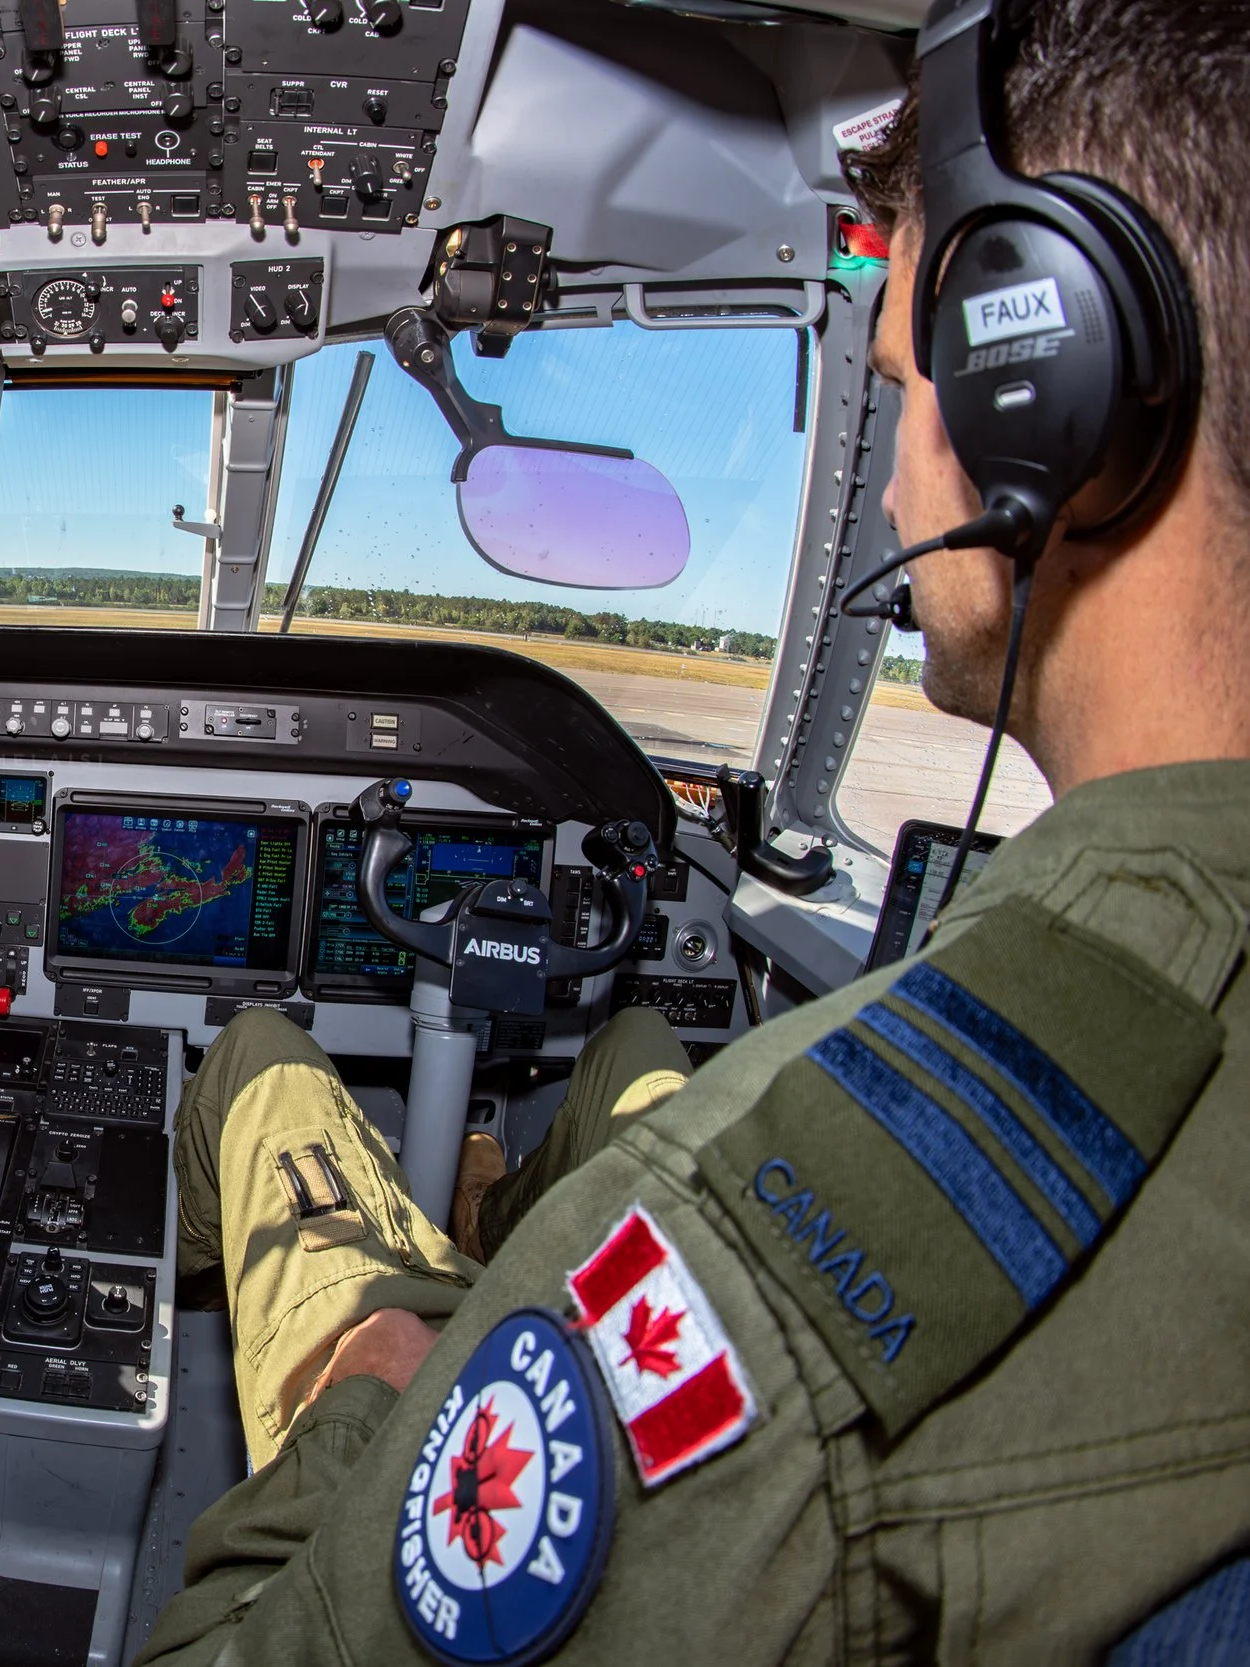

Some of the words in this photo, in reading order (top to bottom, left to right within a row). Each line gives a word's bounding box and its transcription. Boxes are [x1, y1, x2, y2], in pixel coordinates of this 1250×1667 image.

[293, 14, 312, 22] COLD
[349, 17, 368, 25] COLD
[64, 29, 98, 40] FLIGHT
[101, 28, 127, 37] DECK
[124, 80, 155, 88] CENTRAL
[330, 80, 348, 89] CVR
[65, 86, 96, 95] CENTRAL
[304, 126, 344, 135] INTERNAL
[347, 128, 358, 136] LT
[841, 119, 873, 138] ESCAPE
[90, 133, 118, 141] ERASE
[120, 132, 142, 140] TEST
[58, 161, 89, 169] STATUS
[146, 158, 191, 166] HEADPHONE
[92, 178, 146, 186] FEATHER/APR
[980, 290, 1052, 329] FAUX
[953, 328, 1076, 377] BOSE
[374, 718, 396, 727] CAUTION
[373, 738, 397, 746] WARNING
[463, 938, 541, 965] AIRBUS
[753, 1156, 918, 1364] CANADA
[45, 1357, 68, 1366] AERIAL
[70, 1359, 86, 1367] DLVY
[509, 1329, 583, 1585] CANADA
[400, 1384, 464, 1641] KINGFISHER
